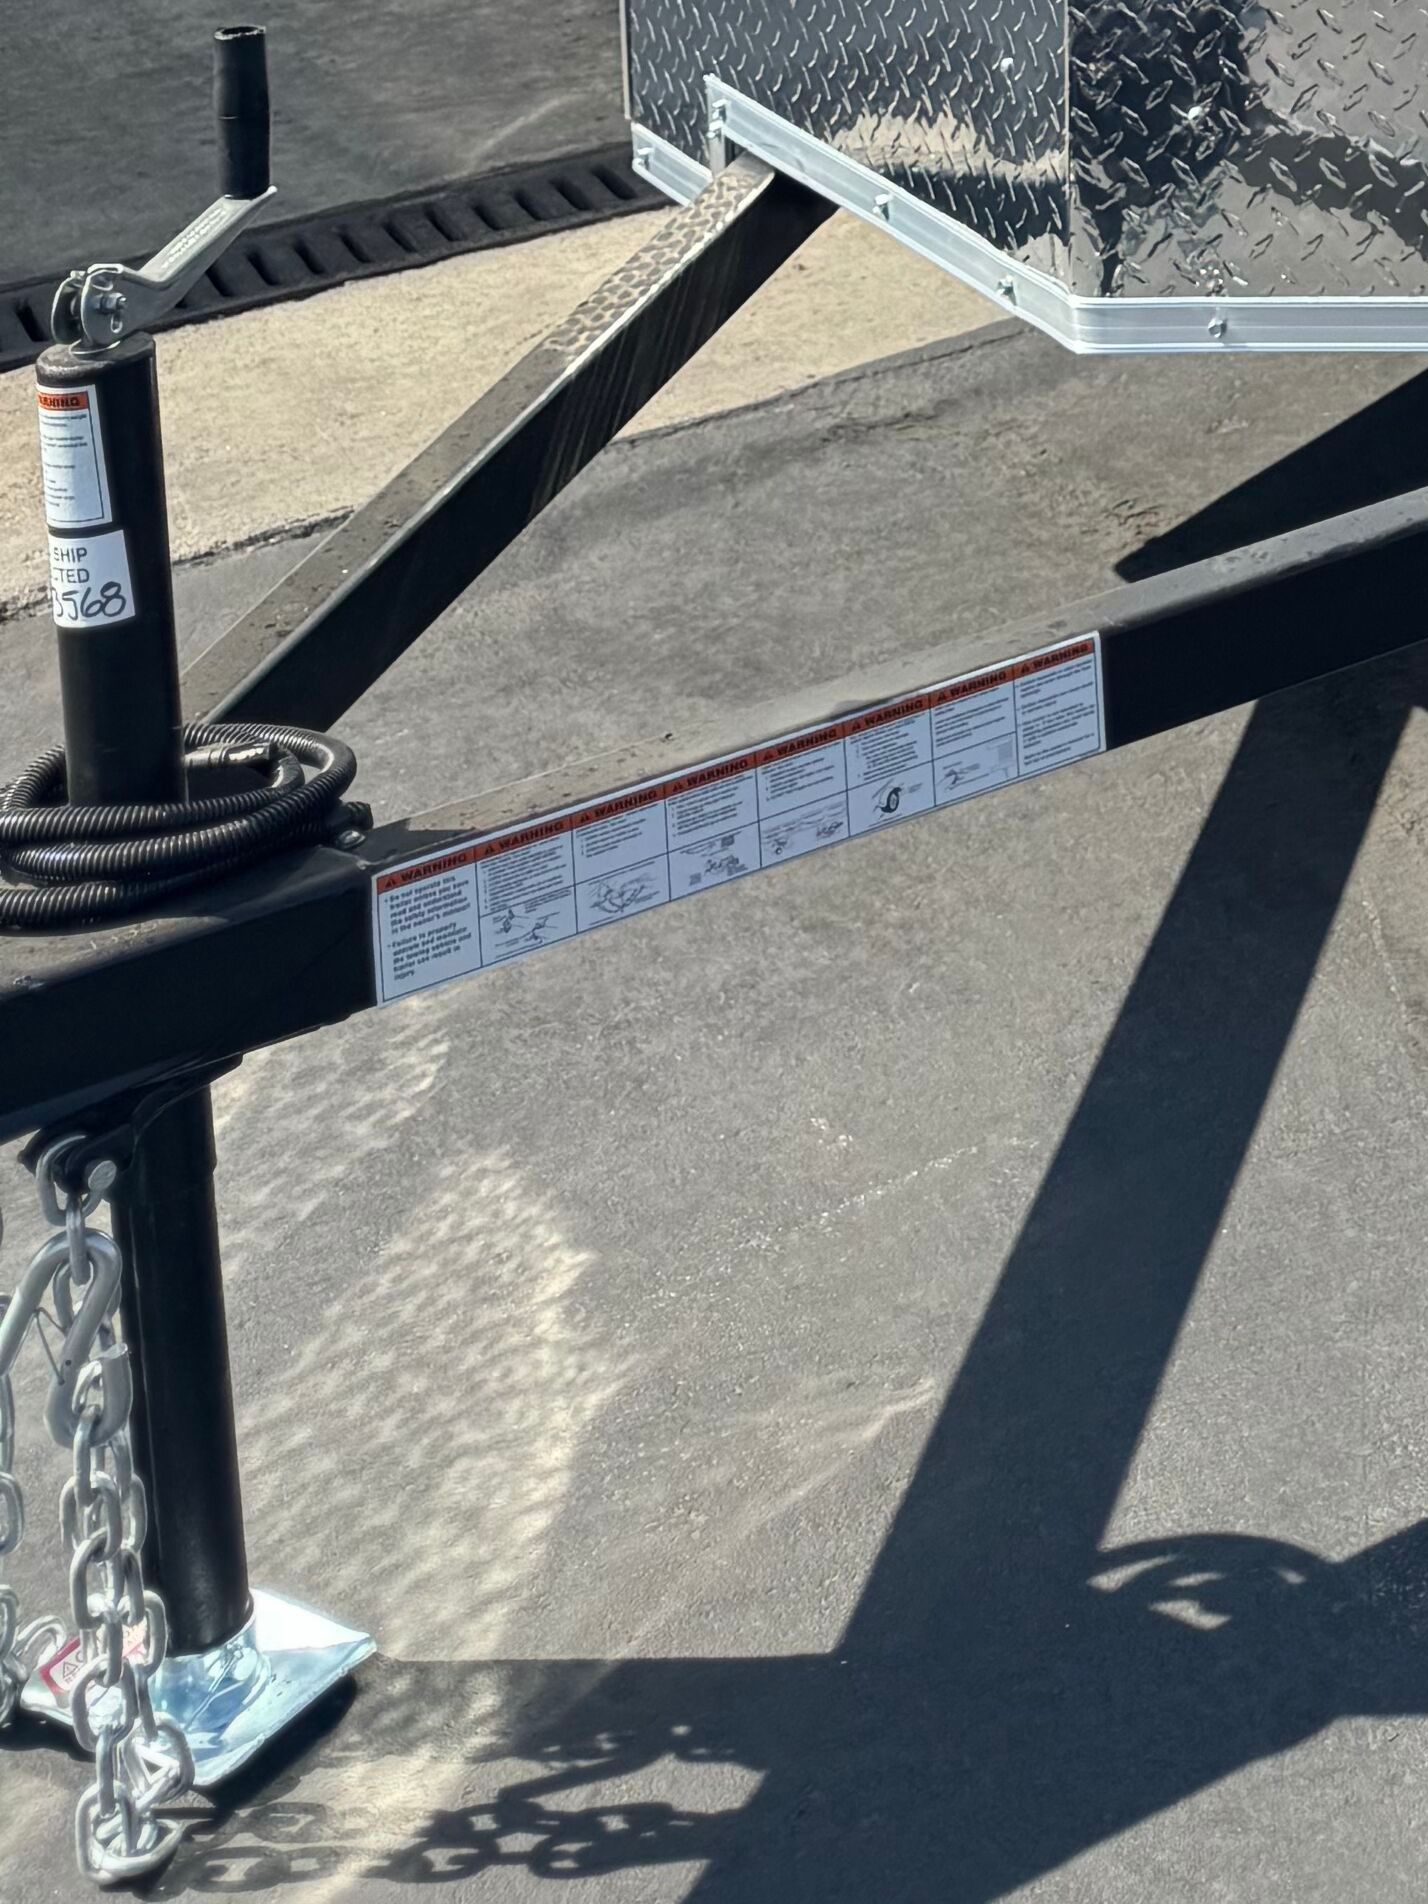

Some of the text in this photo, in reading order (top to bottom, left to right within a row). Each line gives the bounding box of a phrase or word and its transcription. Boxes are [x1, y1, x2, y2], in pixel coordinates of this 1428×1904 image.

[1033, 644, 1089, 668] WARNING
[951, 672, 1007, 694] WARNING
[866, 700, 923, 723] WARNING
[777, 729, 837, 755] WARNING
[688, 760, 748, 785] WARNING
[595, 791, 658, 817] WARNING
[500, 821, 564, 847] WARNING
[401, 853, 467, 881] WARNING
